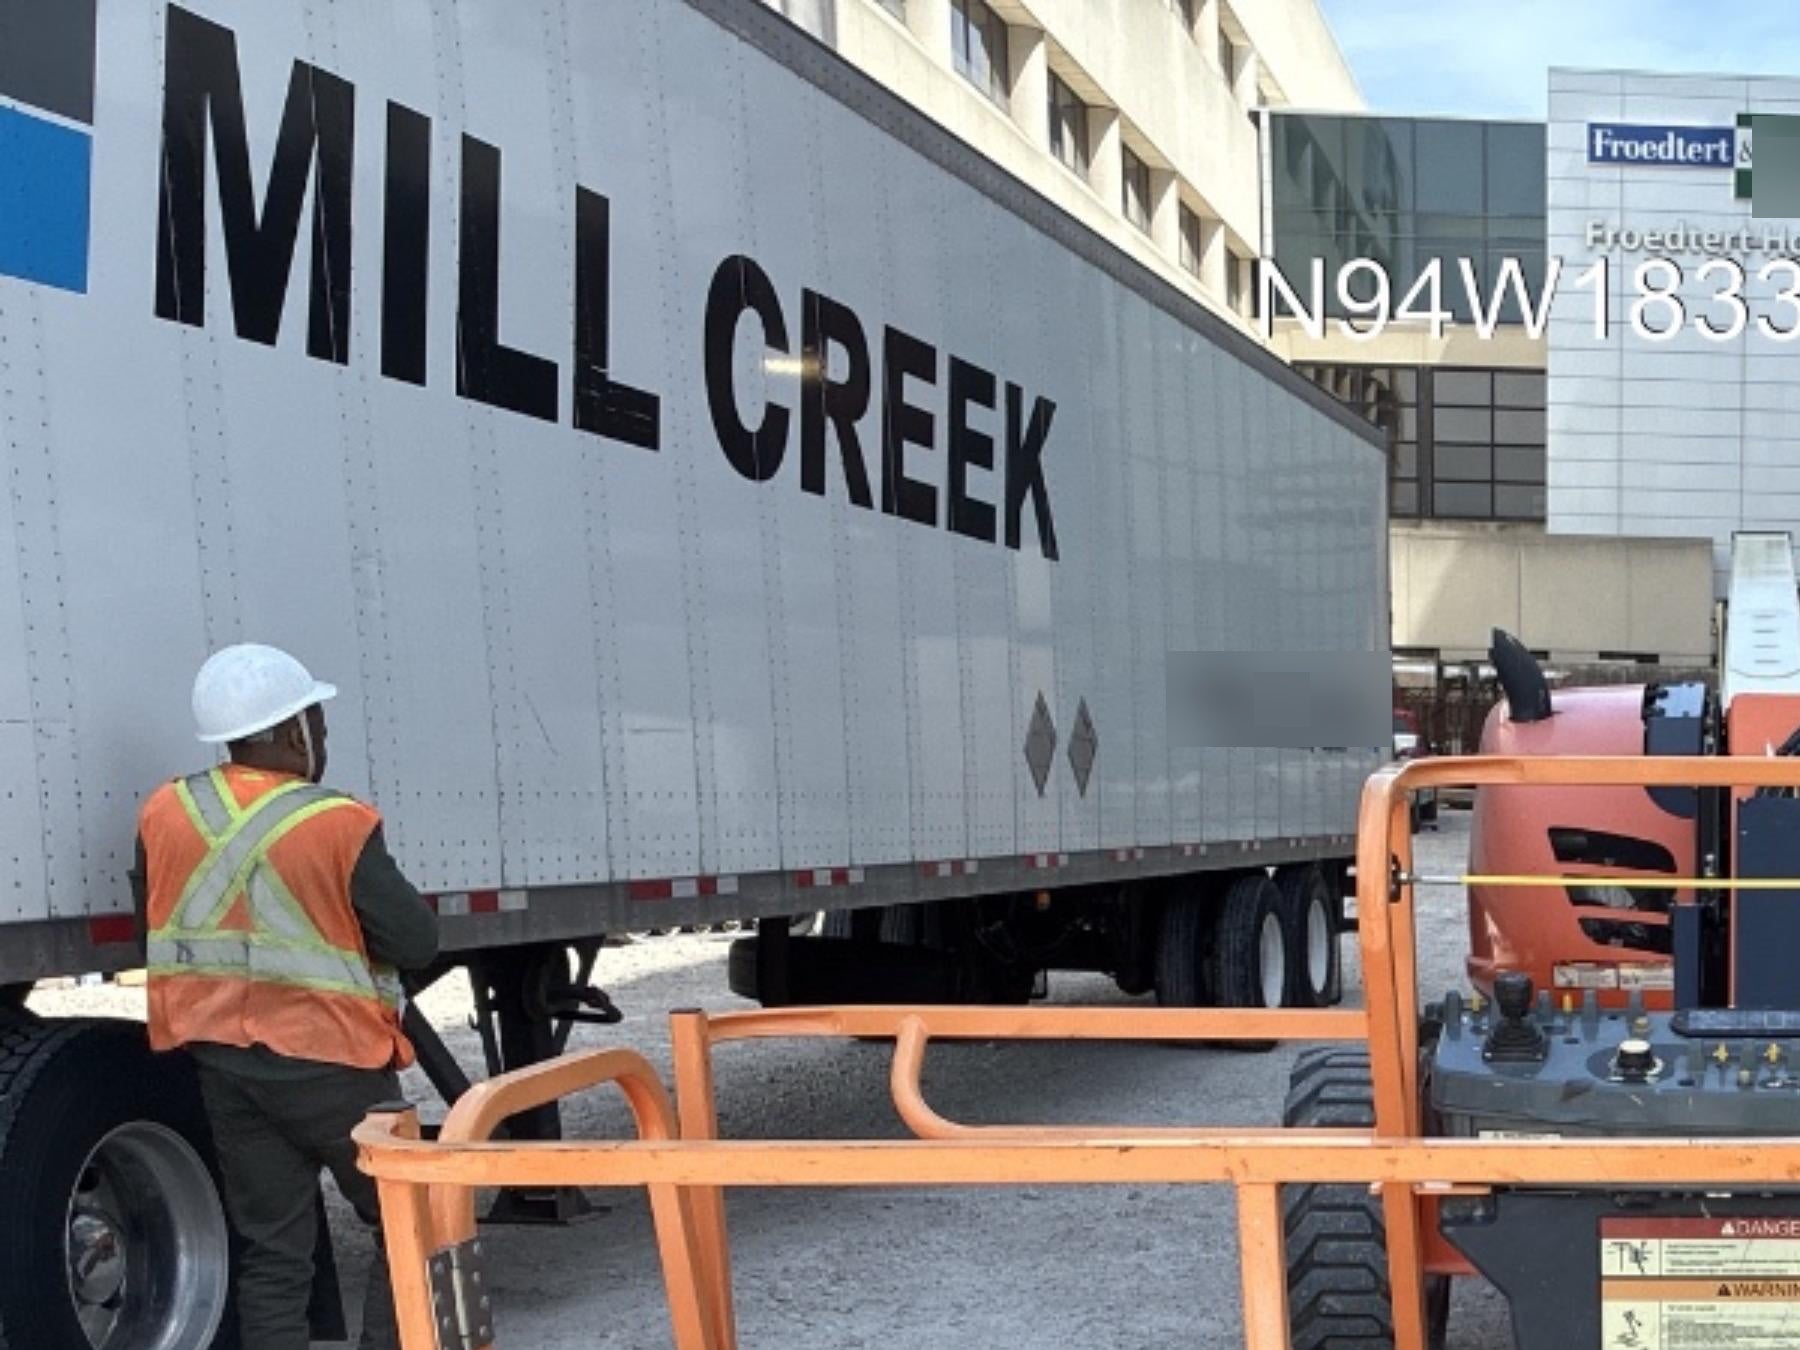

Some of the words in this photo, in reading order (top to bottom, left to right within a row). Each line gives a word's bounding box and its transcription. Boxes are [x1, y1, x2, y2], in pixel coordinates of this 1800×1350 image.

[1593, 127, 1732, 165] Froedtert
[1585, 220, 1754, 253] Froedtert
[155, 2, 660, 450] MILL
[703, 254, 1059, 561] CREEK
